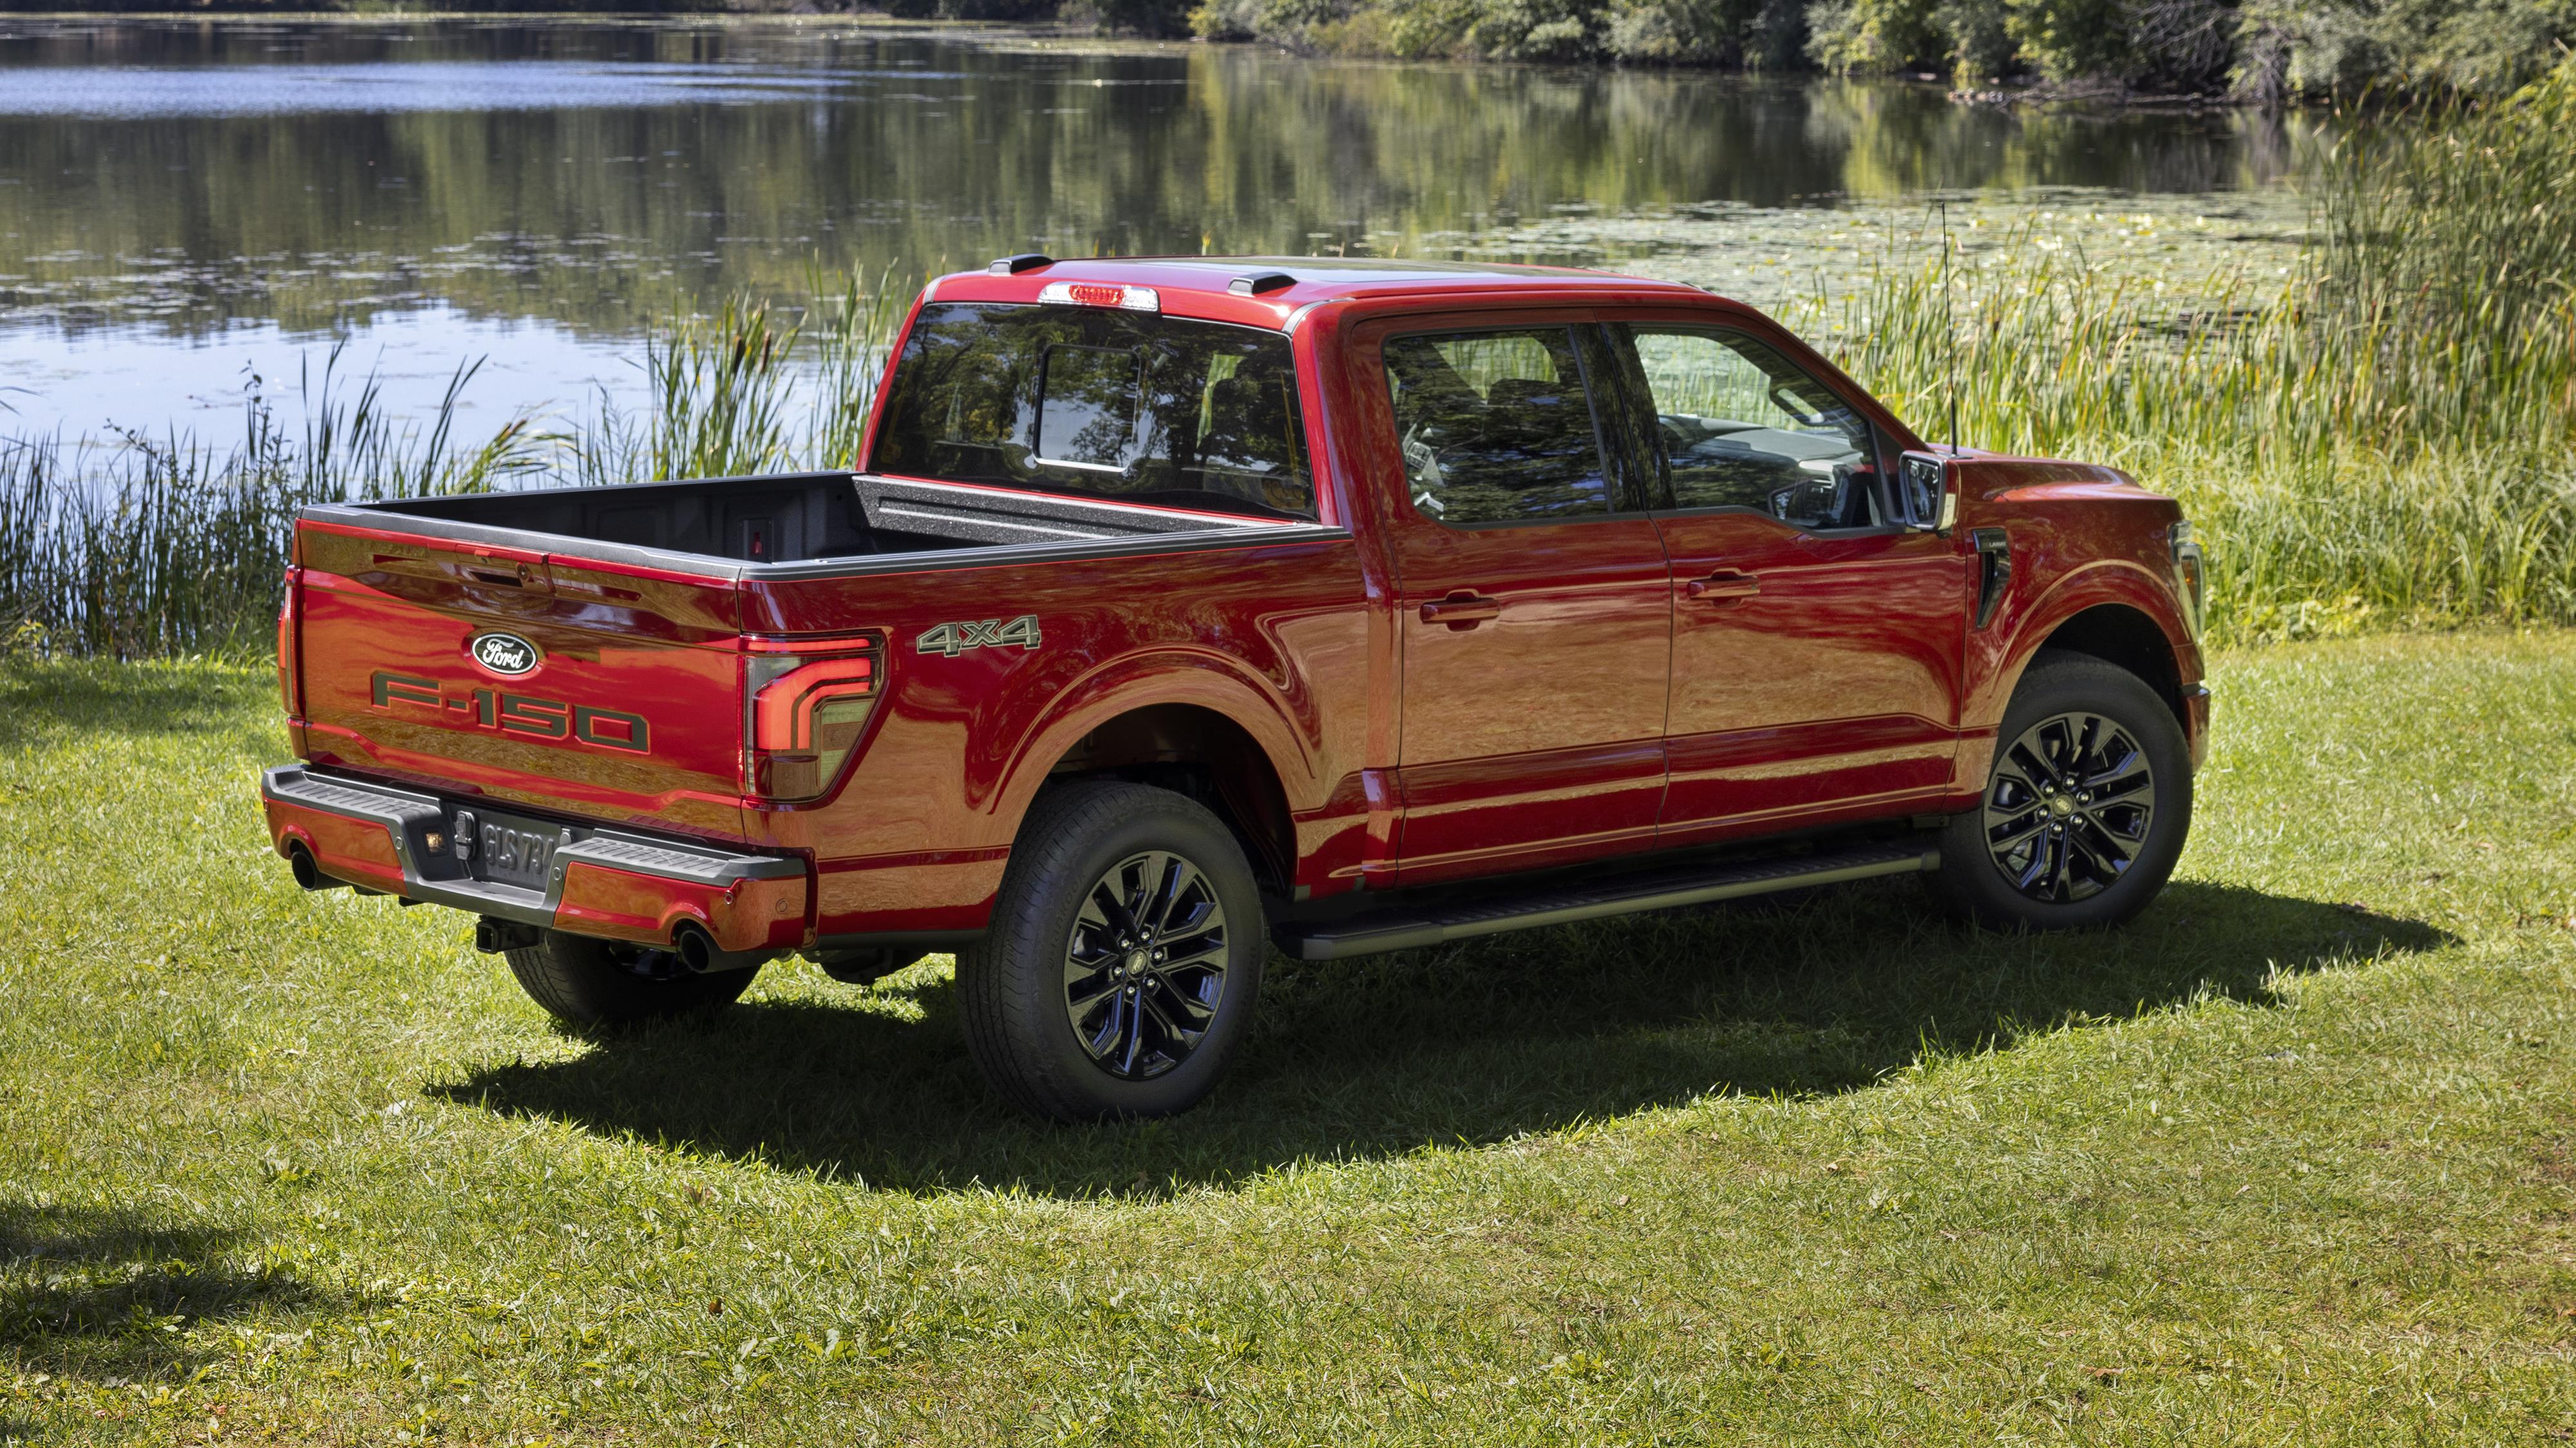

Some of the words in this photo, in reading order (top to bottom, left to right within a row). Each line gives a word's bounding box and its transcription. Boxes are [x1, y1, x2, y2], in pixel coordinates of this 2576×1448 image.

[482, 638, 524, 668] Ford
[371, 670, 651, 756] F-150
[484, 823, 518, 870] GLS
